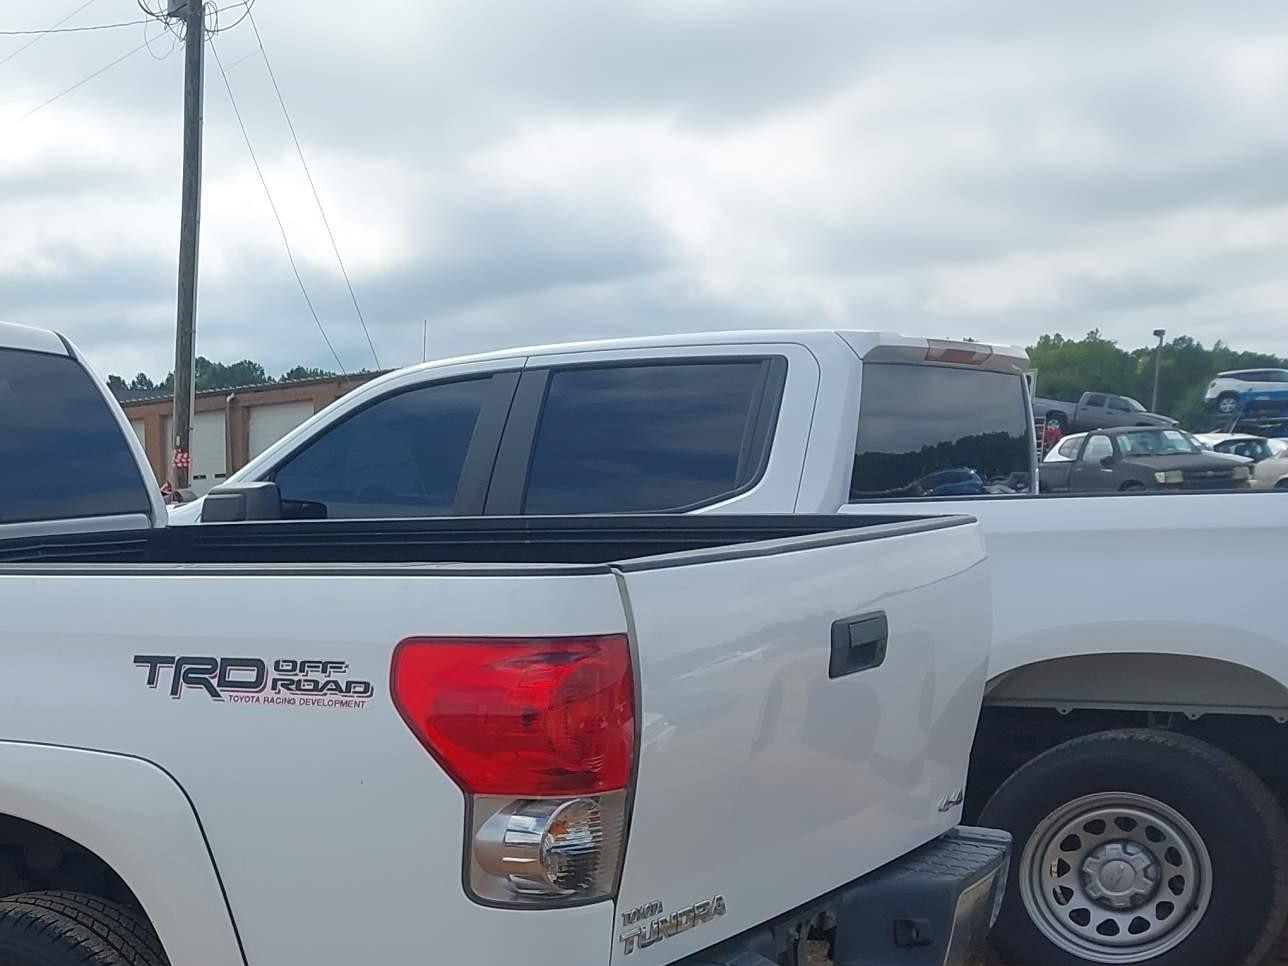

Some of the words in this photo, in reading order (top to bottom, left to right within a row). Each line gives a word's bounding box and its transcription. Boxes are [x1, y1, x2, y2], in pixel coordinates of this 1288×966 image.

[133, 655, 268, 701] TRD
[273, 659, 349, 677] OFF
[270, 678, 374, 698] ROAD
[228, 695, 262, 704] TOYOTA
[262, 696, 297, 706] RACING
[299, 698, 366, 709] DEVELOPMENT
[620, 895, 727, 955] TUNDRA
